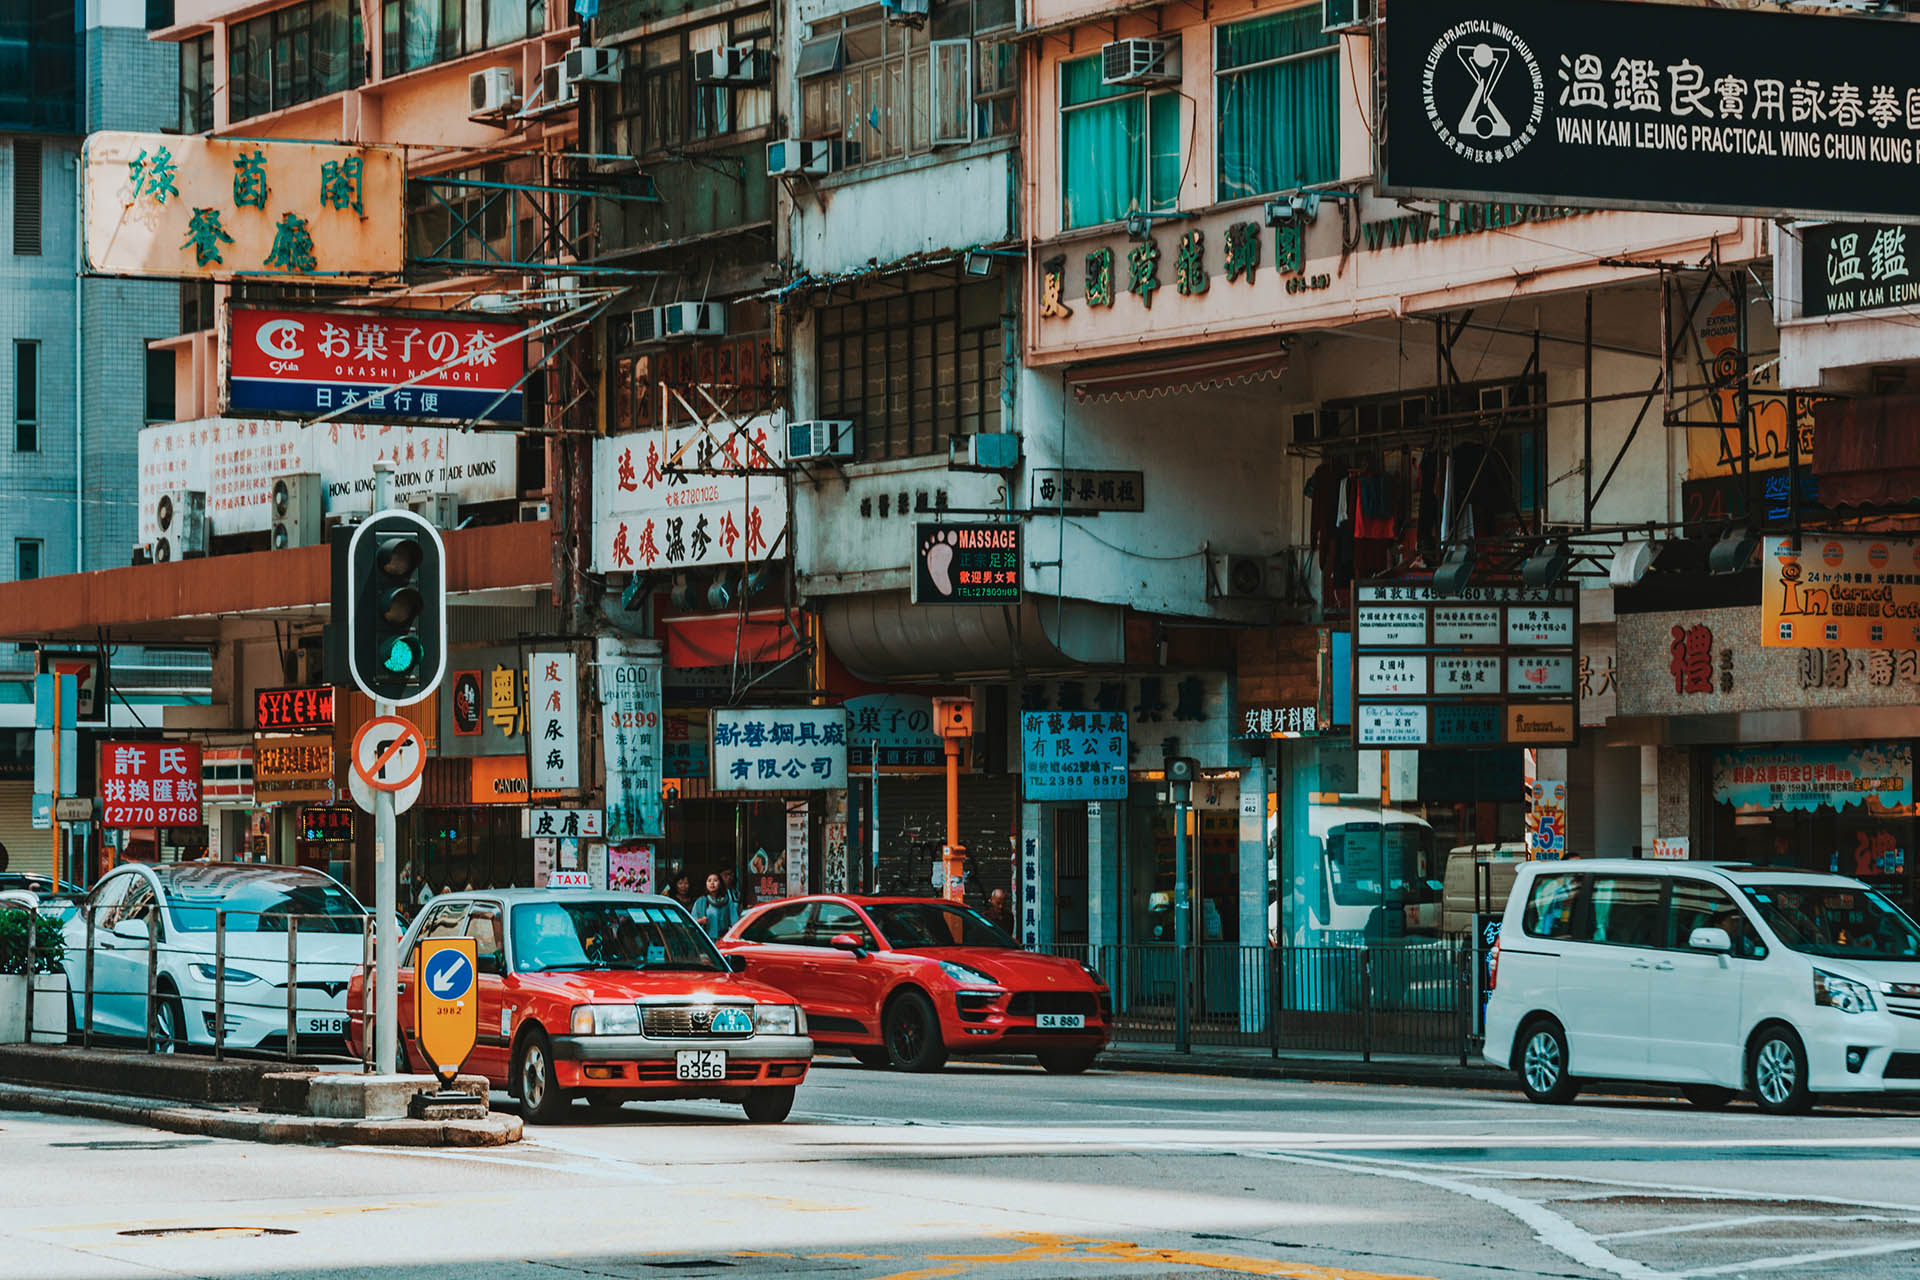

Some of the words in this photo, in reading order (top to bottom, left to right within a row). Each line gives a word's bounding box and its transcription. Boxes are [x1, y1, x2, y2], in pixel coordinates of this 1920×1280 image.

[1443, 20, 1491, 45] PRACTICAL
[1492, 22, 1514, 41] WING
[1425, 38, 1448, 71] LEUNG
[1511, 35, 1534, 63] CHUN
[1422, 69, 1435, 95] KAM
[1528, 61, 1544, 89] KUNG
[1423, 95, 1439, 120] WAN
[1534, 90, 1545, 105] FU
[1556, 117, 1592, 144] WAN
[1597, 120, 1631, 147] KAM
[1635, 122, 1688, 150] LEUNG
[1691, 126, 1777, 156] PRACTICAL
[1780, 131, 1820, 158] WING
[1824, 134, 1866, 160] CHUN
[1870, 137, 1912, 164] KUNG
[180, 207, 317, 272] 餐廳
[1827, 226, 1909, 286] 溫鑑
[1827, 292, 1855, 311] WAN
[1860, 287, 1885, 307] KAM
[317, 322, 498, 367] お菓子の森
[1700, 326, 1738, 339] BROADBAN
[335, 366, 397, 378] OKASHI
[439, 371, 480, 382] MORI
[316, 388, 440, 412] 日本直行便
[329, 480, 350, 497] HONG
[354, 477, 376, 493] KONG
[425, 467, 434, 482] OF
[467, 460, 496, 476] UNIONS
[959, 529, 1016, 549] MASSAGE
[615, 667, 648, 683] GOD
[487, 663, 530, 737] 粵
[543, 660, 565, 770] 皮膚尿病
[1031, 736, 1122, 758] 有限公司
[115, 747, 188, 775] 許氏
[730, 756, 833, 781] 有限公司
[104, 779, 198, 803] 找換匯款
[493, 778, 528, 793] CANTON
[116, 807, 154, 823] 2770
[158, 806, 198, 822] 8768
[536, 811, 580, 837] 皮膚
[556, 874, 588, 885] TAXI
[436, 1006, 463, 1015] 3982
[1042, 1015, 1056, 1026] SA
[310, 1020, 329, 1031] SH
[690, 1050, 712, 1065] JZ
[679, 1064, 722, 1078] 8356
